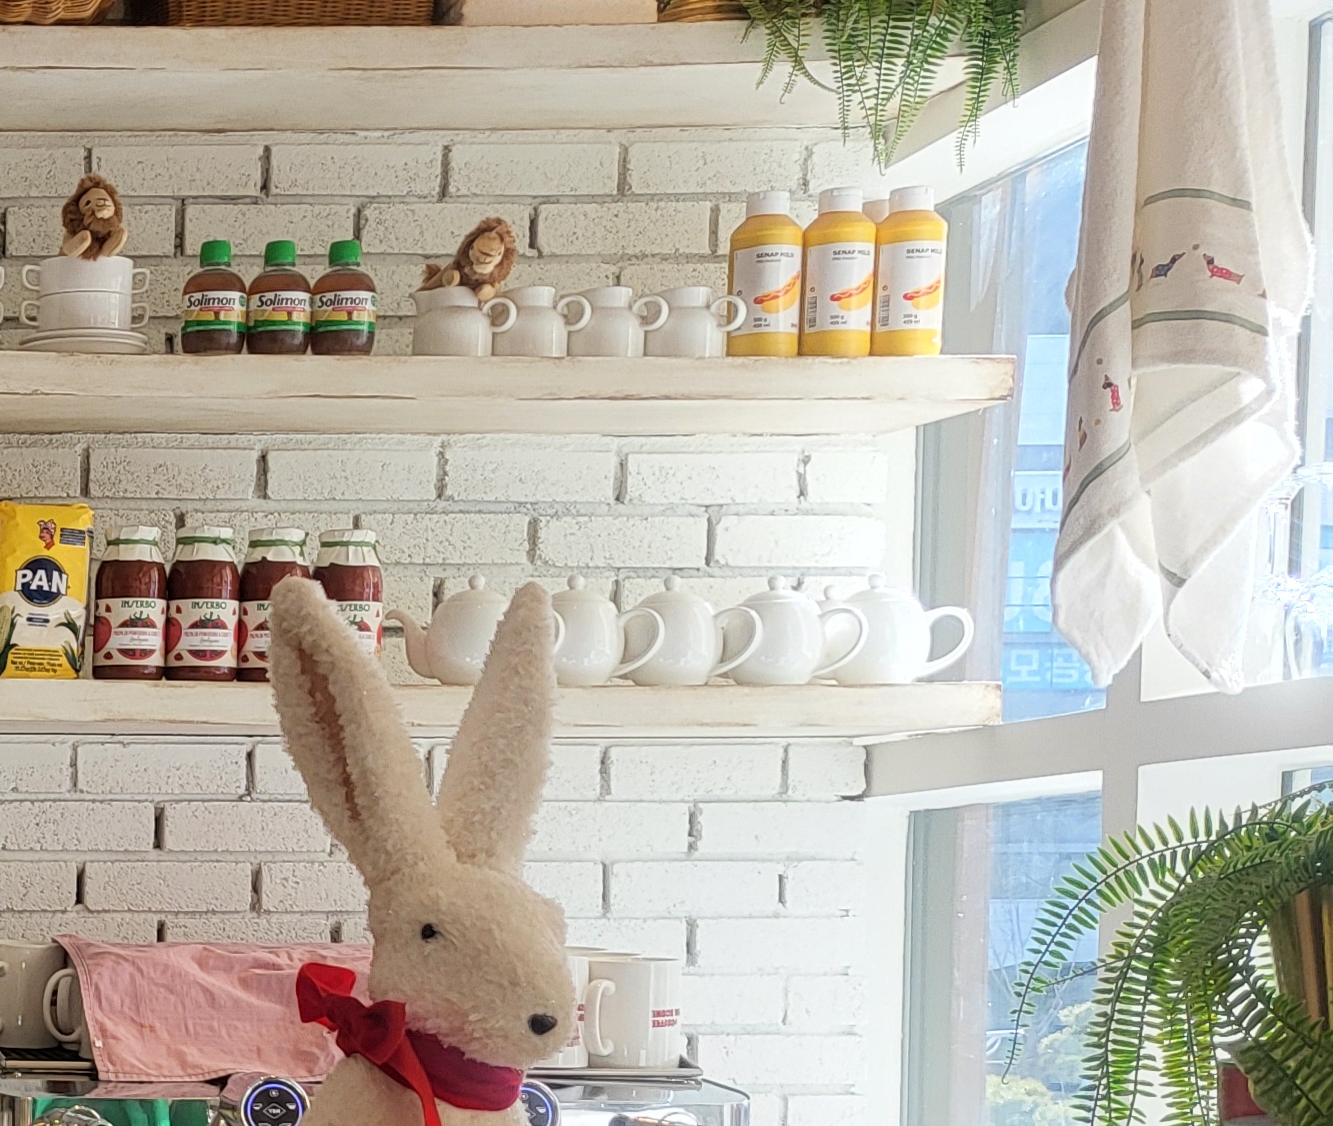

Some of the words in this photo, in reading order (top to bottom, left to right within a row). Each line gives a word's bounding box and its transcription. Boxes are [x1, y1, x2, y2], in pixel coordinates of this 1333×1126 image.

[187, 293, 235, 308] Solimon
[257, 293, 306, 308] Solimon
[317, 293, 368, 309] Solimon
